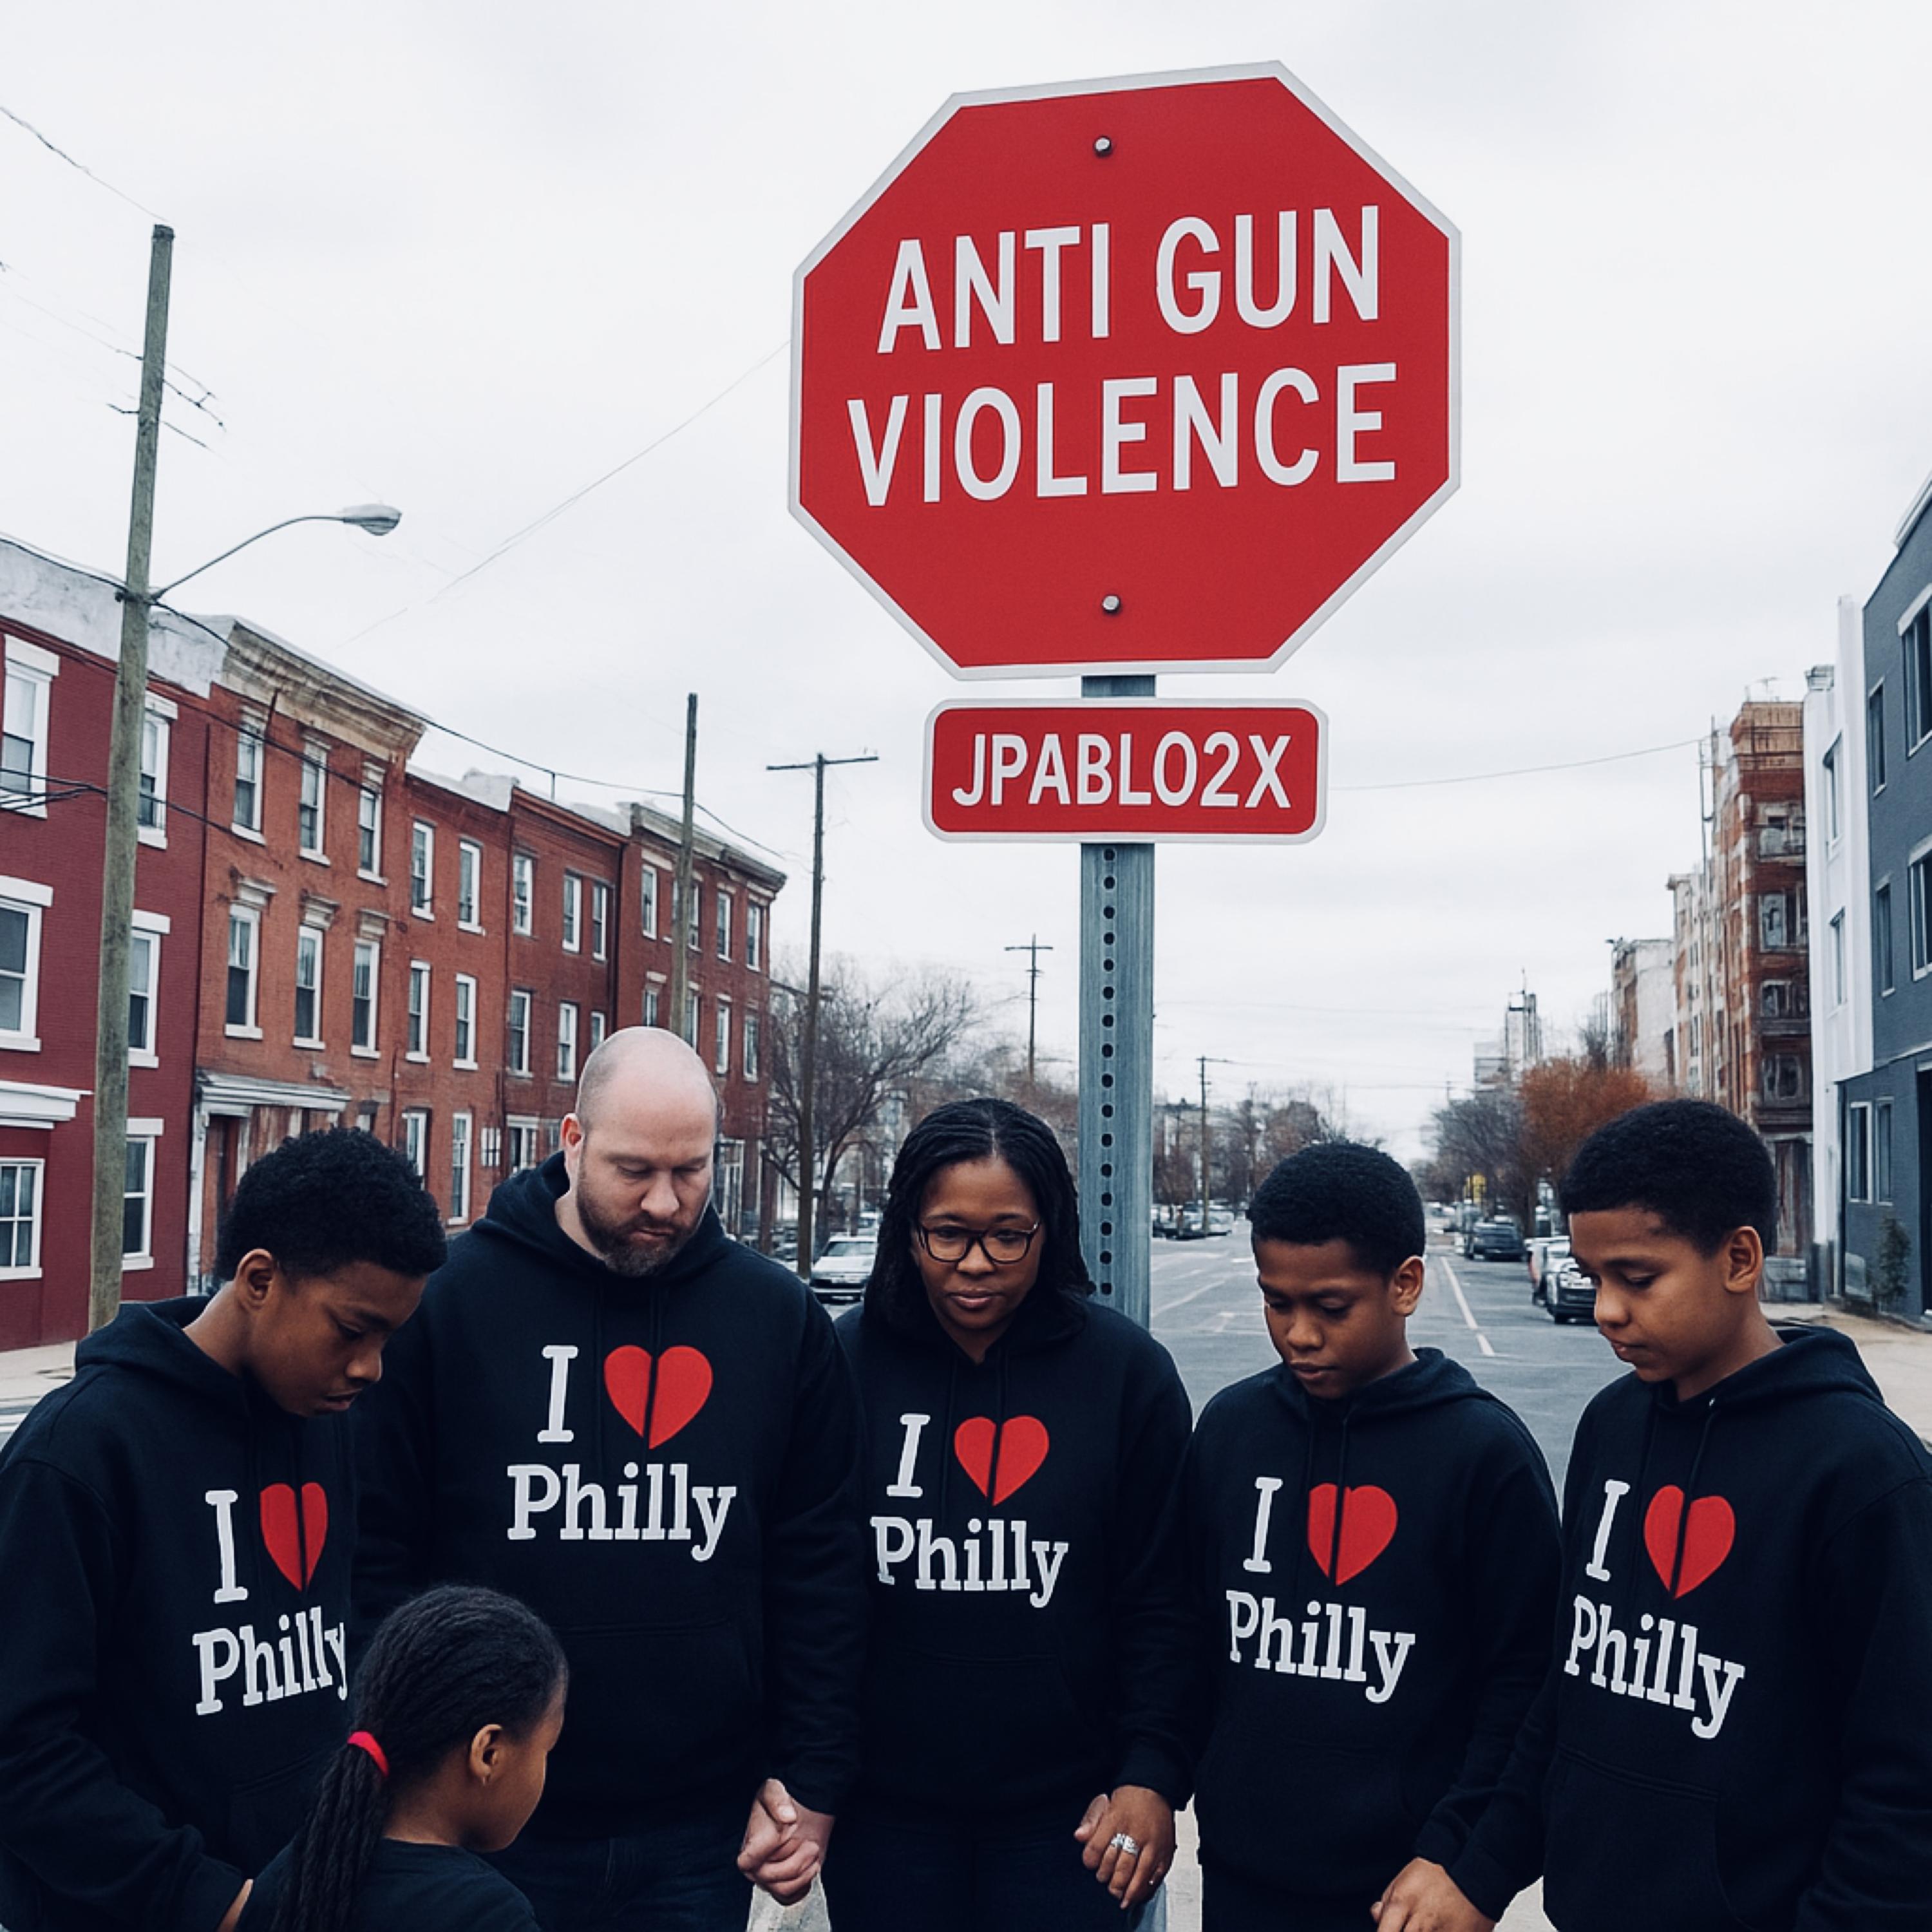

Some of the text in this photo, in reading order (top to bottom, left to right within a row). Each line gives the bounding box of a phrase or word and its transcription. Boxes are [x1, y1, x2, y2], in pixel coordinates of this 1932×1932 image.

[876, 205, 1379, 354] ANTI GUN
[846, 362, 1397, 507] VIOLENCE
[951, 731, 1292, 809] JPABLO2X
[537, 1345, 578, 1444] I
[886, 1412, 931, 1499] I
[205, 1489, 249, 1605] I
[506, 1461, 737, 1562] Philly
[869, 1515, 1070, 1609] Philly
[1243, 1476, 1284, 1575] I
[1585, 1478, 1631, 1583] I
[191, 1605, 348, 1716] Philly
[1225, 1589, 1416, 1704] Philly
[1563, 1594, 1746, 1739] Philly
